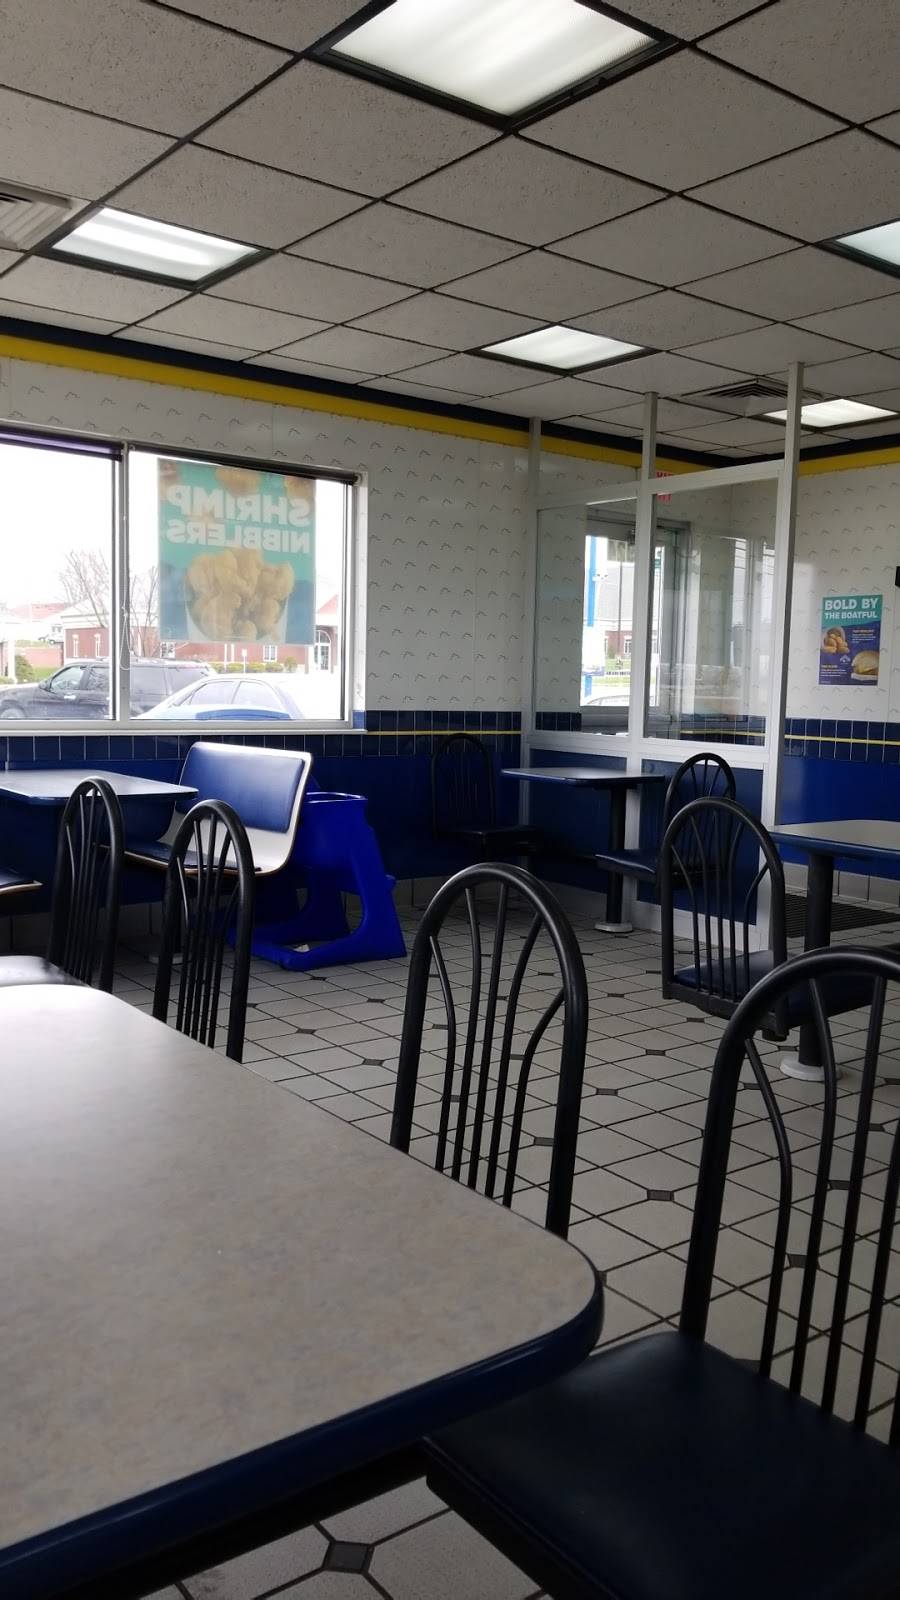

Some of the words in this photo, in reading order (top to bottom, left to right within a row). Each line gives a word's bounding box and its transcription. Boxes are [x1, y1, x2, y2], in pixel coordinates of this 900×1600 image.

[825, 599, 857, 610] BOLD
[861, 598, 878, 609] BY
[841, 611, 877, 619] BOATFUL
